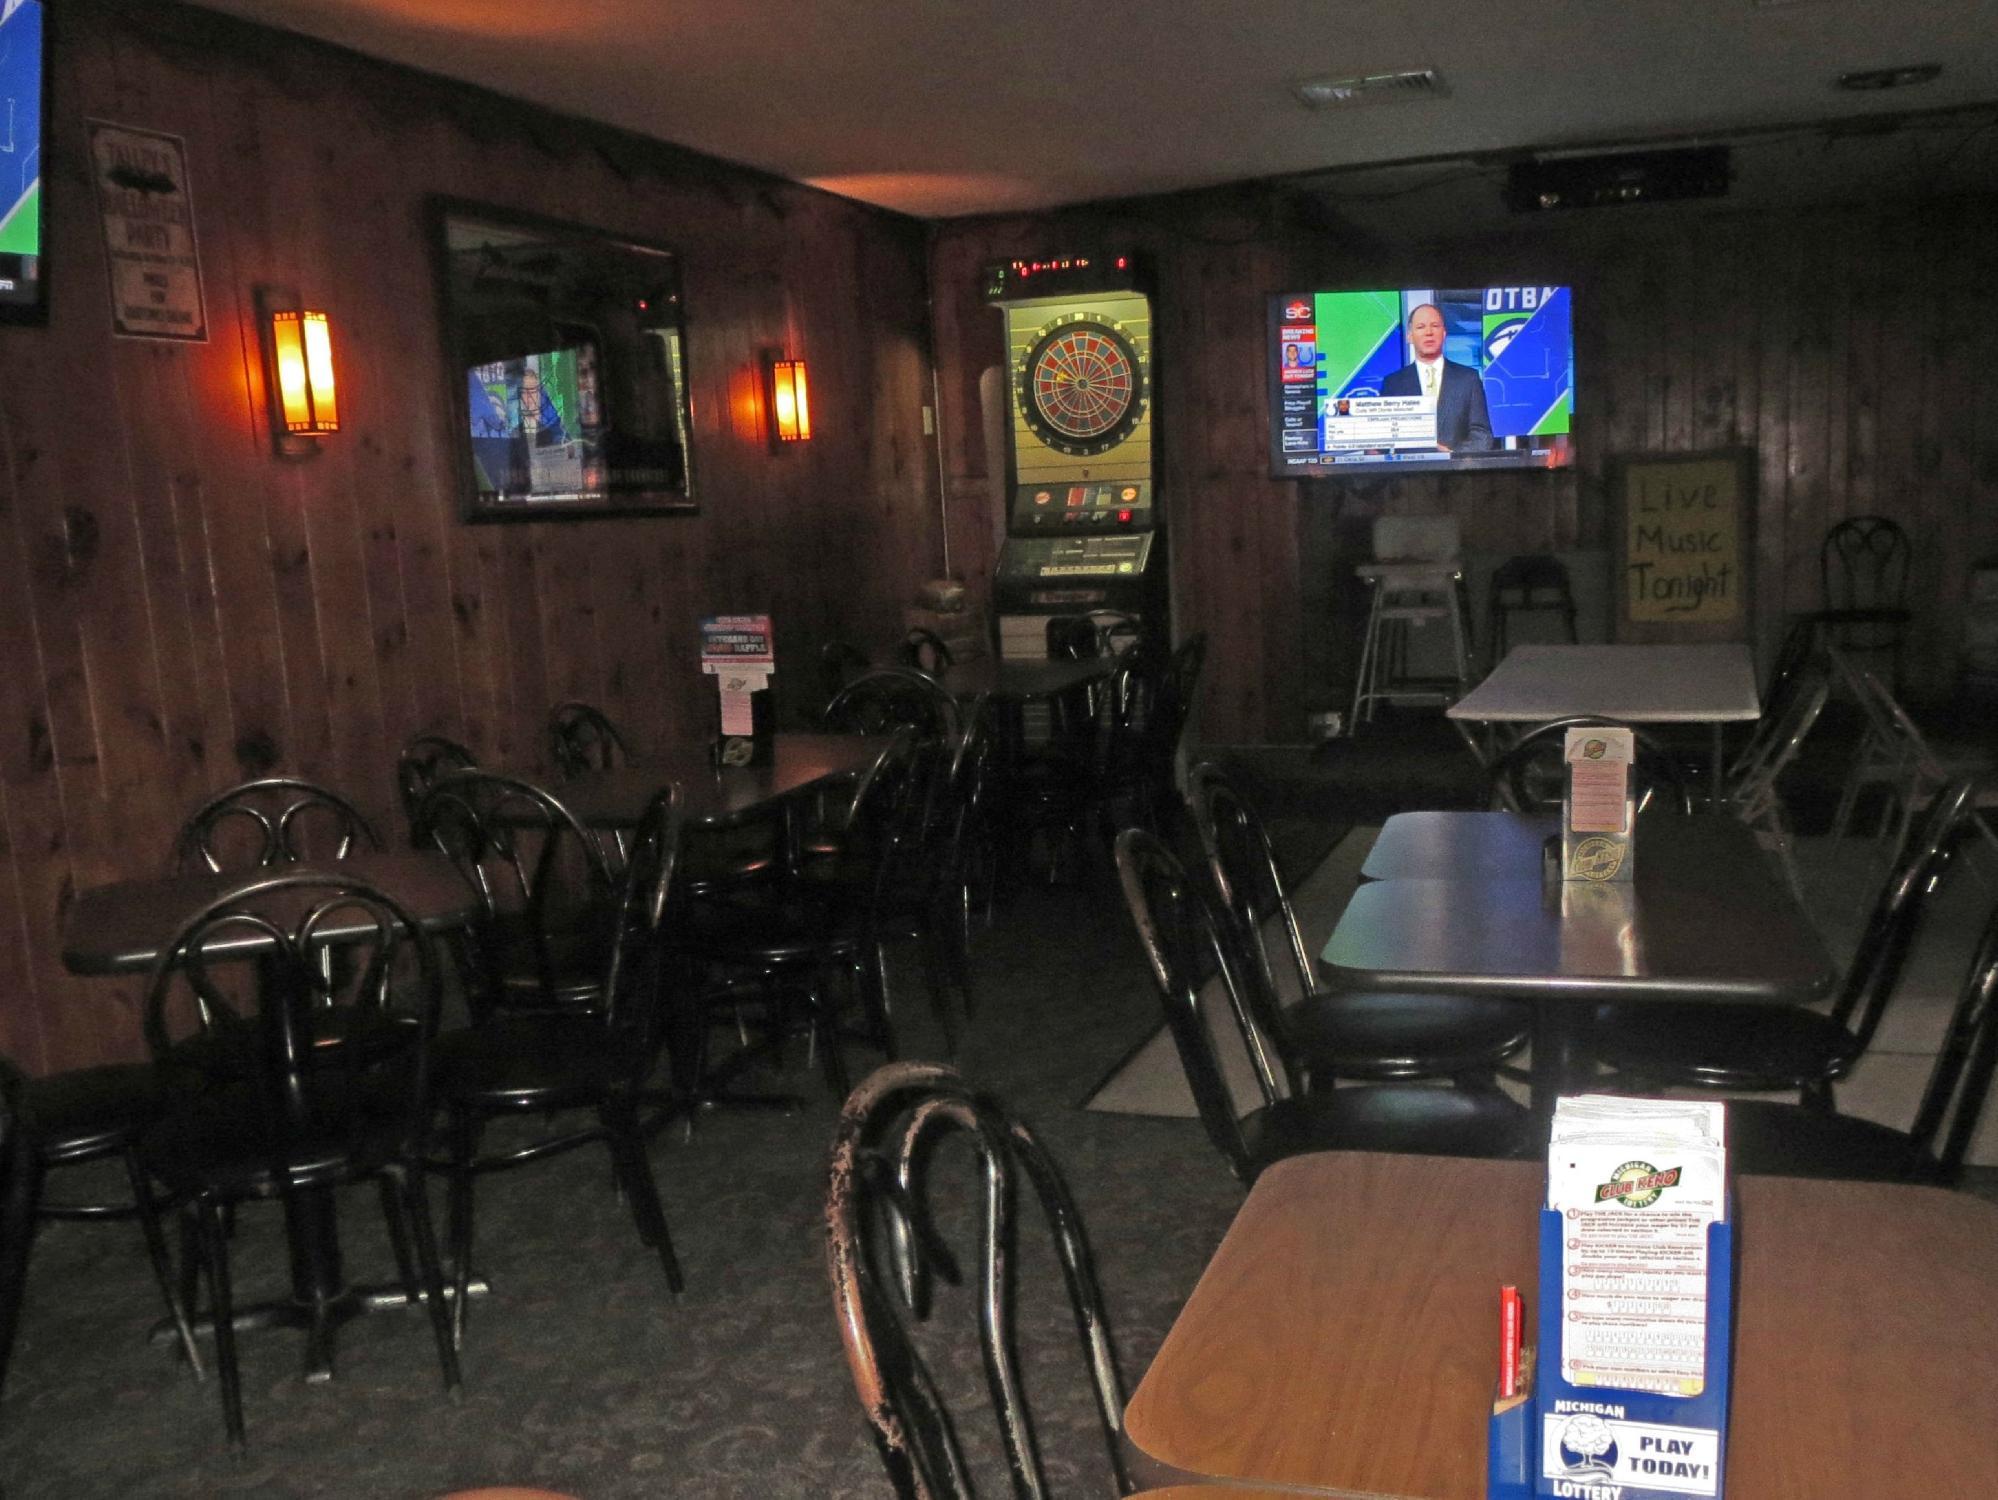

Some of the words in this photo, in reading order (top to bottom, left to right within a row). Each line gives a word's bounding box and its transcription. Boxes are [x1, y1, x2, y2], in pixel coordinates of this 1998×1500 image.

[1286, 307, 1311, 318] SC
[1640, 481, 1718, 512] Live
[1637, 525, 1722, 554] Music
[1627, 561, 1733, 611] Tonight
[1612, 1160, 1653, 1180] MICHIGAN
[1600, 1181, 1634, 1200] CLUB
[1636, 1169, 1679, 1191] KENO
[1554, 1400, 1626, 1419] MICHIGAN
[1640, 1436, 1694, 1456] PLAY
[1628, 1456, 1710, 1480] TODAY!
[1553, 1480, 1623, 1500] LOTTERY
